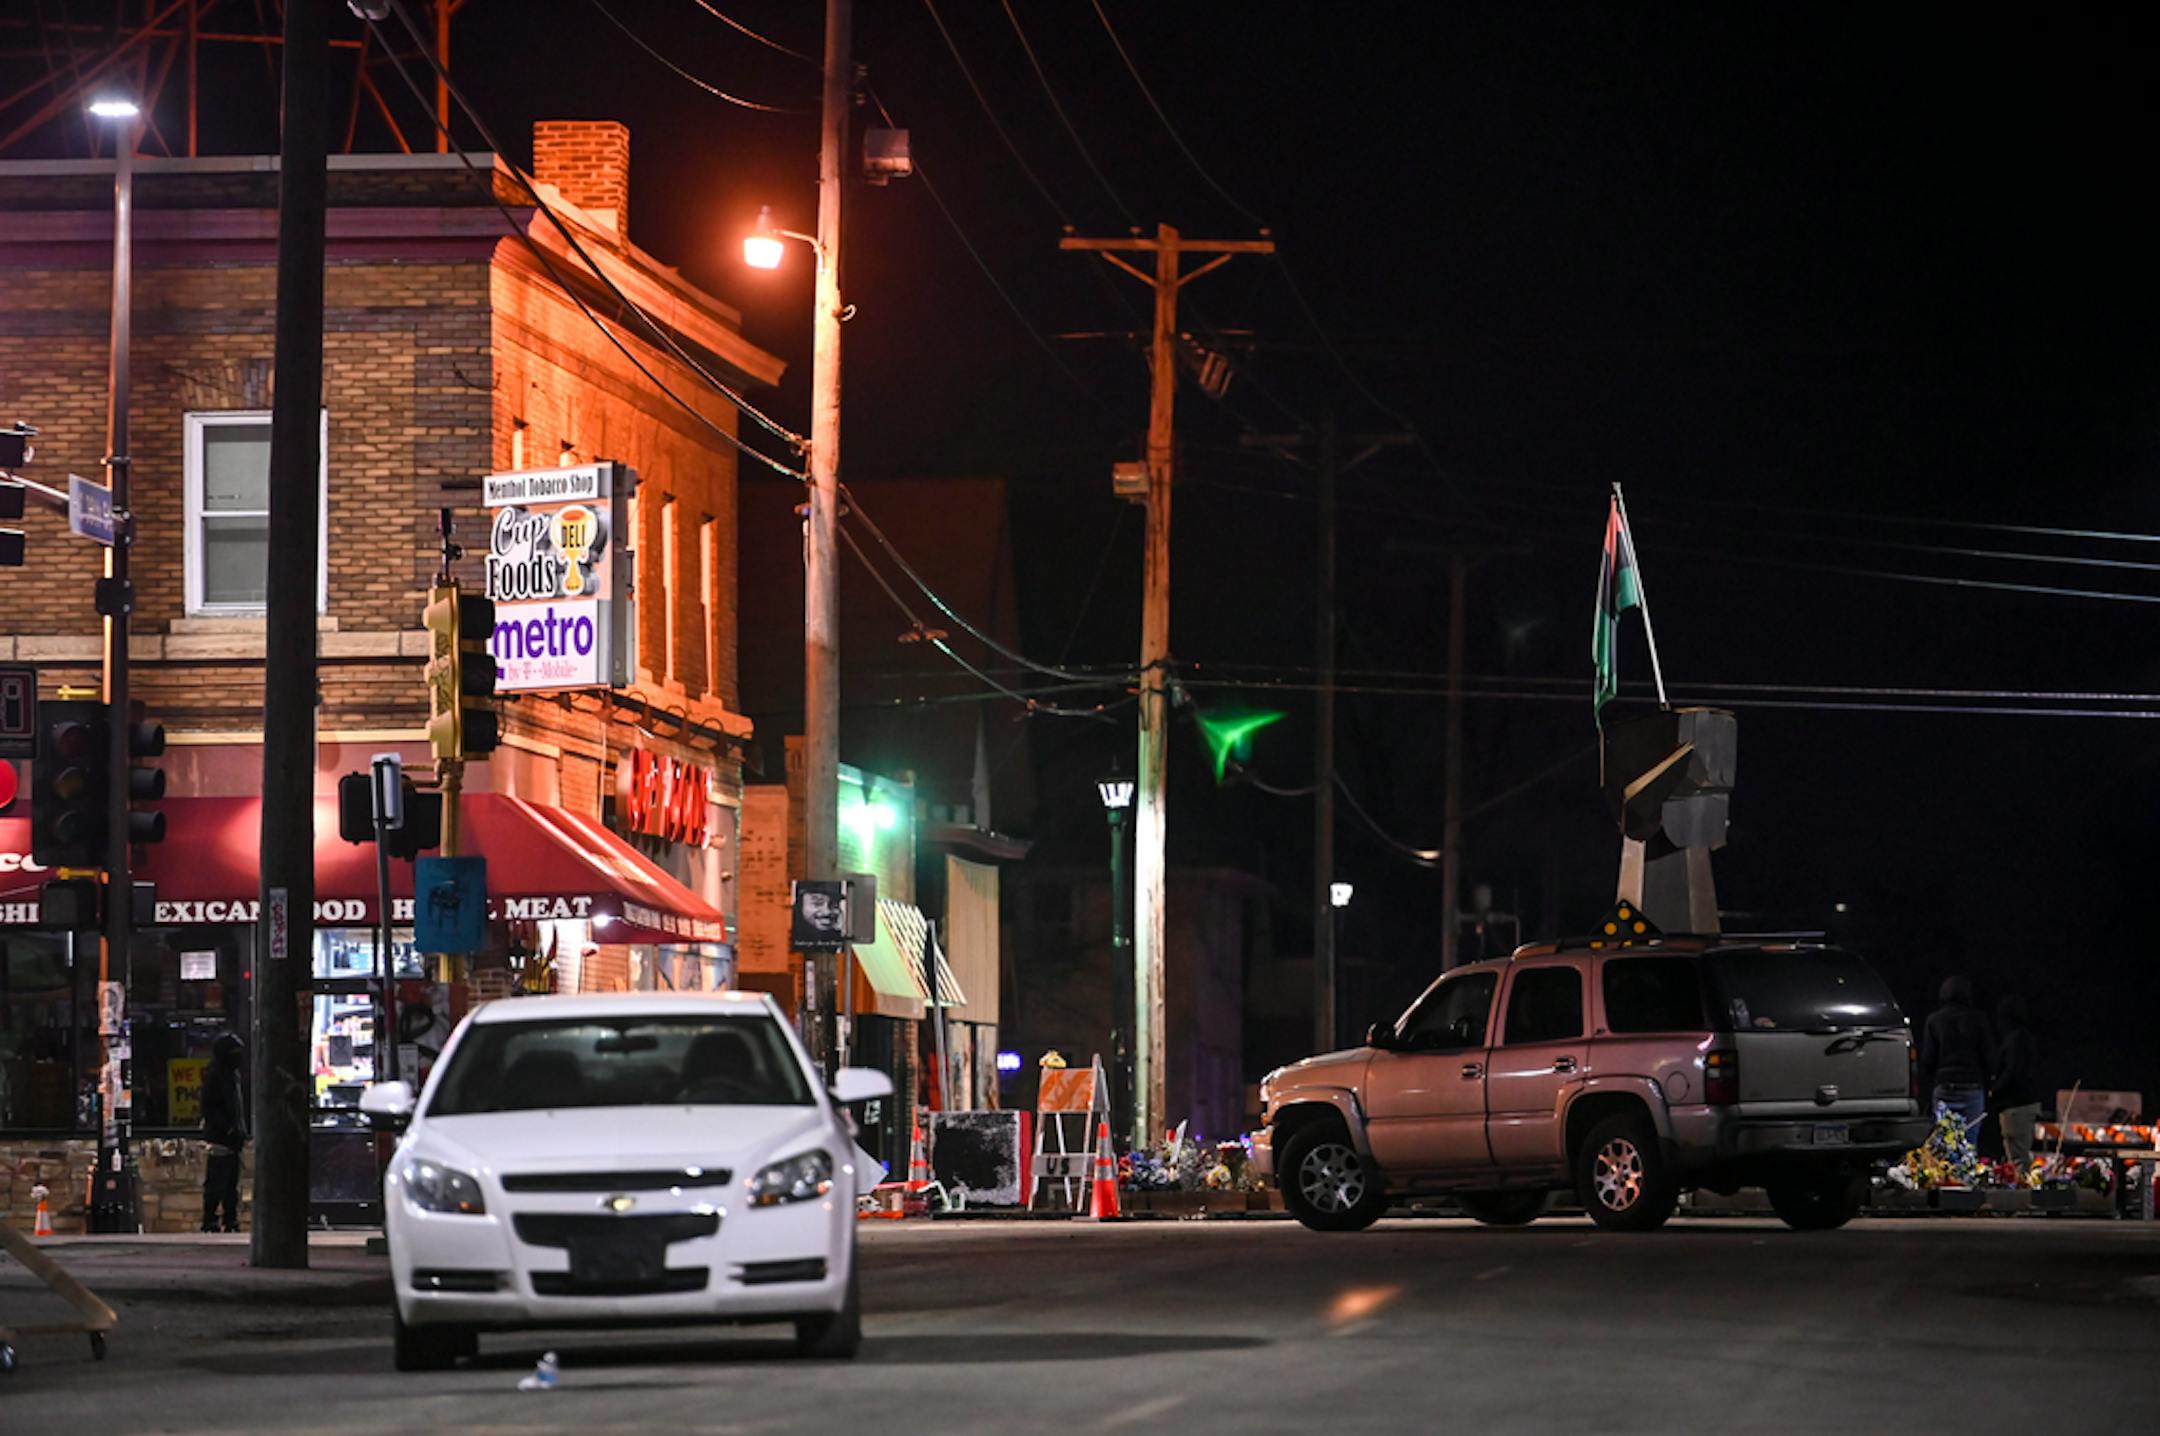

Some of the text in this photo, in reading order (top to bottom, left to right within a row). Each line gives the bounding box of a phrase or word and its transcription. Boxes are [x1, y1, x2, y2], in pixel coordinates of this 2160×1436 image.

[488, 474, 593, 499] Menthol Tobacco Shop
[495, 509, 546, 560] Cup
[561, 524, 585, 548] DELI
[489, 554, 554, 597] Foods
[493, 607, 593, 659] metro
[504, 896, 592, 920] MEAT
